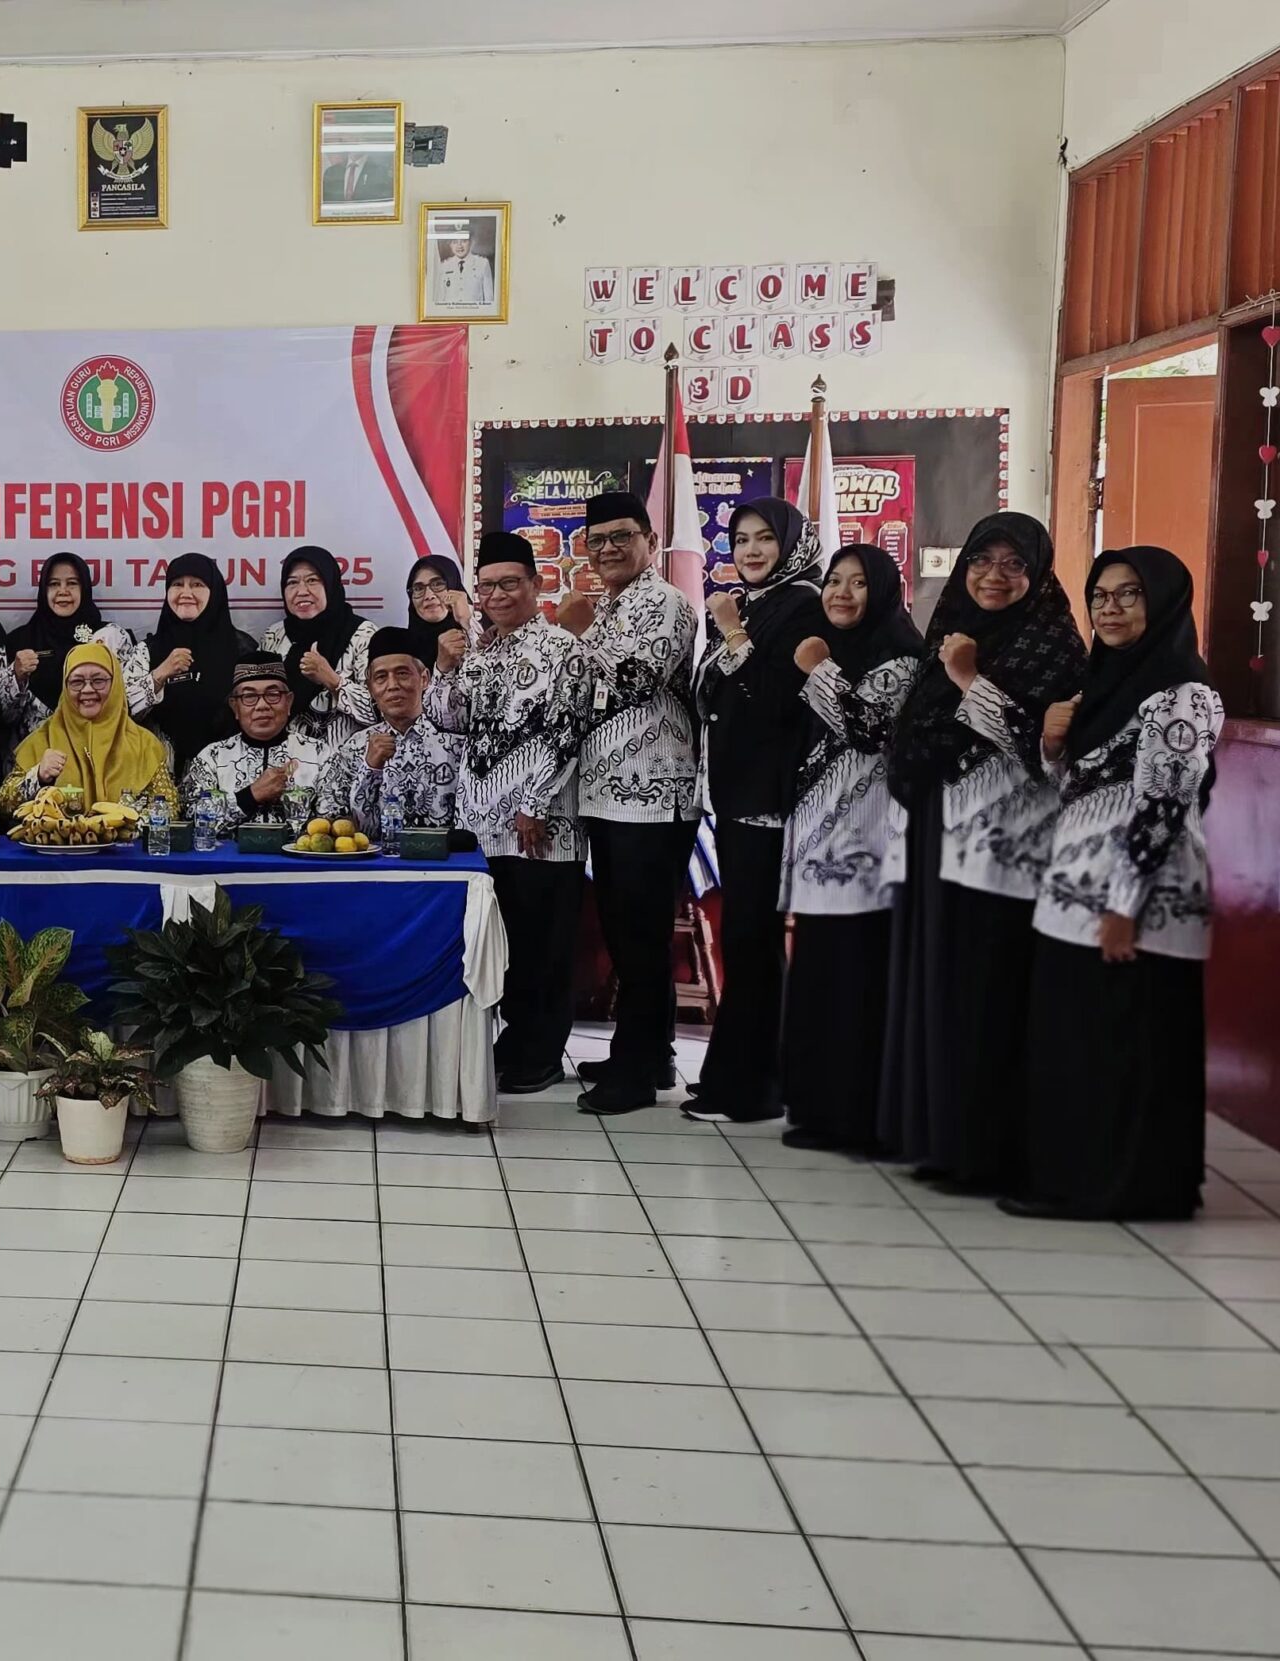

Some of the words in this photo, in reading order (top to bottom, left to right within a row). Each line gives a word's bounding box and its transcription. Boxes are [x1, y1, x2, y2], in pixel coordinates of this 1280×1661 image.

[101, 183, 146, 192] PANCASILA
[591, 272, 868, 304] WELCOME
[591, 326, 655, 354] TO
[690, 320, 872, 352] CLASS
[70, 366, 92, 389] GURU
[124, 365, 151, 401] REPUBLIK
[690, 375, 752, 402] 3D
[65, 390, 92, 441] PERSATUAN
[123, 402, 151, 440] INDONESIA
[95, 435, 121, 446] PGRI
[527, 470, 596, 484] JADWAL
[528, 481, 604, 500] PELAJARAN
[834, 474, 897, 497] DWAL
[202, 480, 306, 538] PGRI
[838, 493, 883, 513] KET
[126, 558, 266, 587] TAUN
